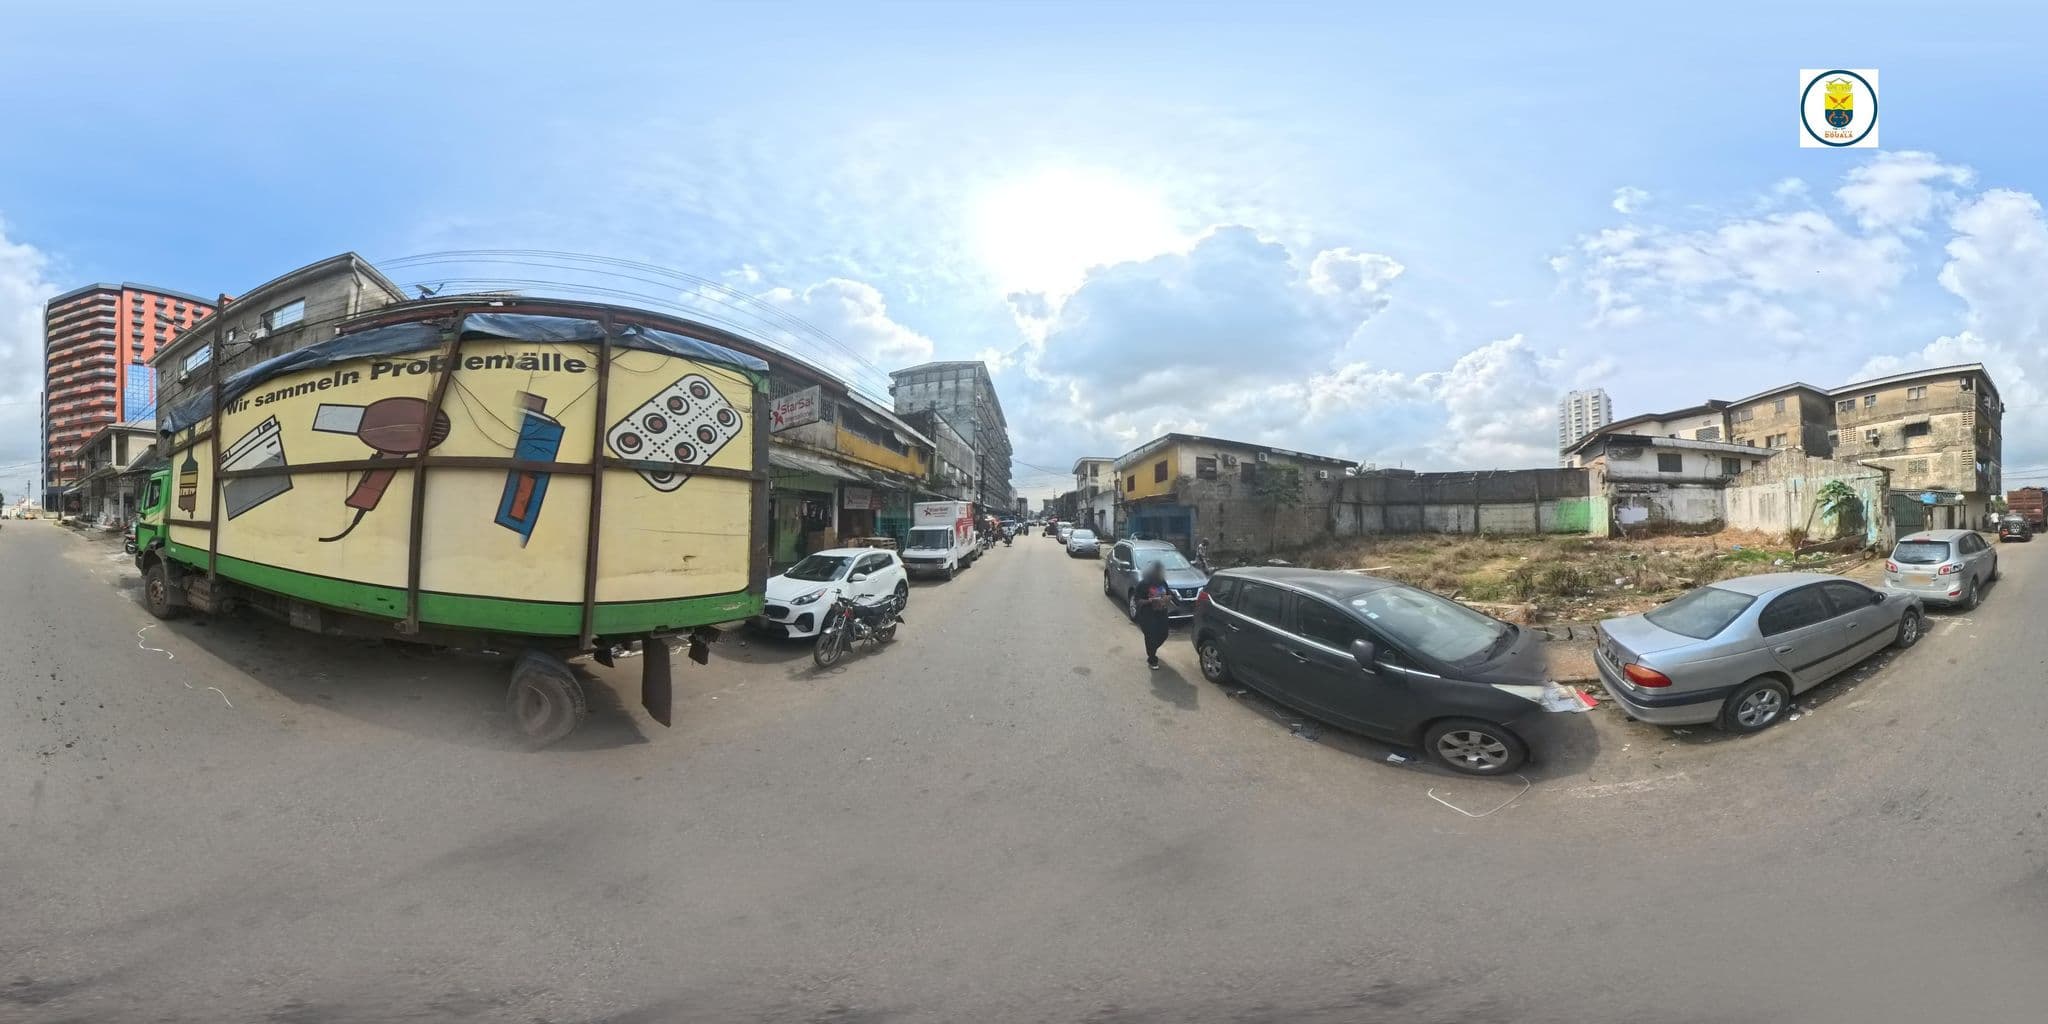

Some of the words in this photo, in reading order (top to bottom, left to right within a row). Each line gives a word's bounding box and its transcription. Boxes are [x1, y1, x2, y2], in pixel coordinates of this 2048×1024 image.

[225, 398, 250, 416] Wir
[254, 370, 360, 407] sammeln
[780, 395, 814, 415] StarSat
